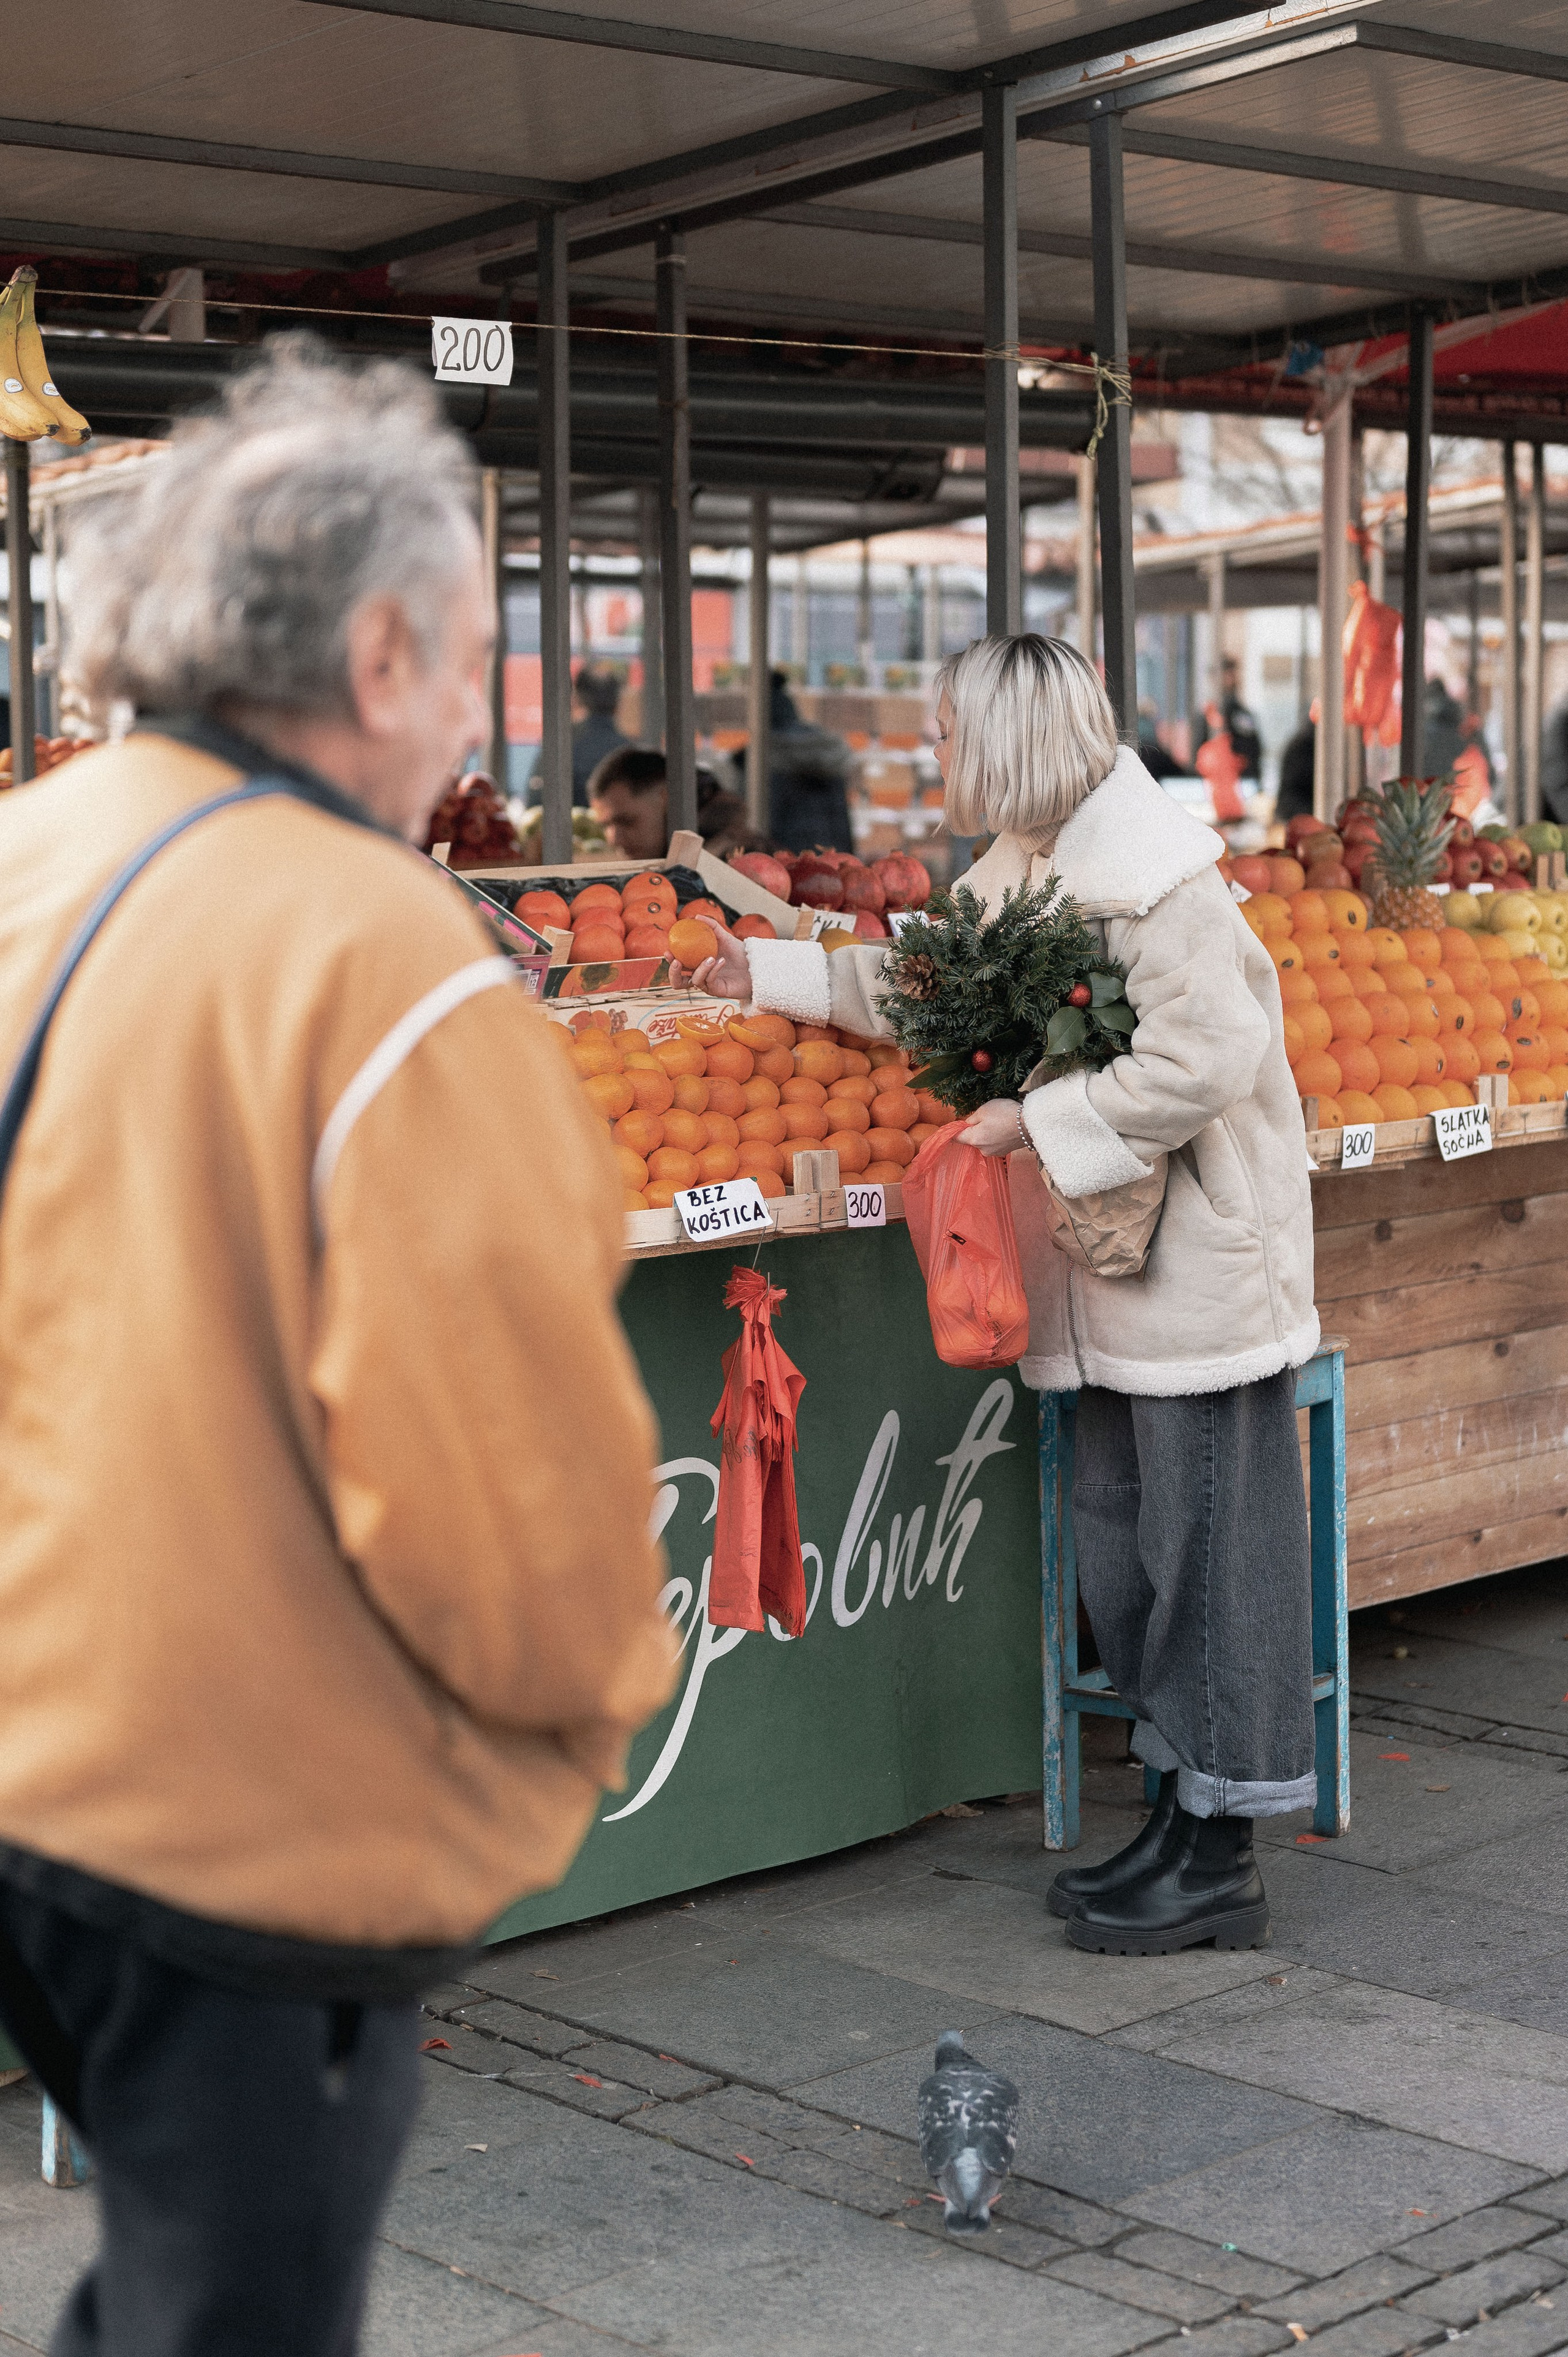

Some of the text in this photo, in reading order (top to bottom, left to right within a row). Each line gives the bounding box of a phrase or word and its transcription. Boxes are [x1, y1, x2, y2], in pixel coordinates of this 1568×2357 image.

[440, 325, 505, 372] 200
[1441, 1106, 1490, 1133] SLATKA
[1345, 1131, 1373, 1158] 300
[687, 1185, 728, 1207] BEZ
[848, 1191, 881, 1218] 300
[686, 1201, 766, 1234] KOŠTICA
